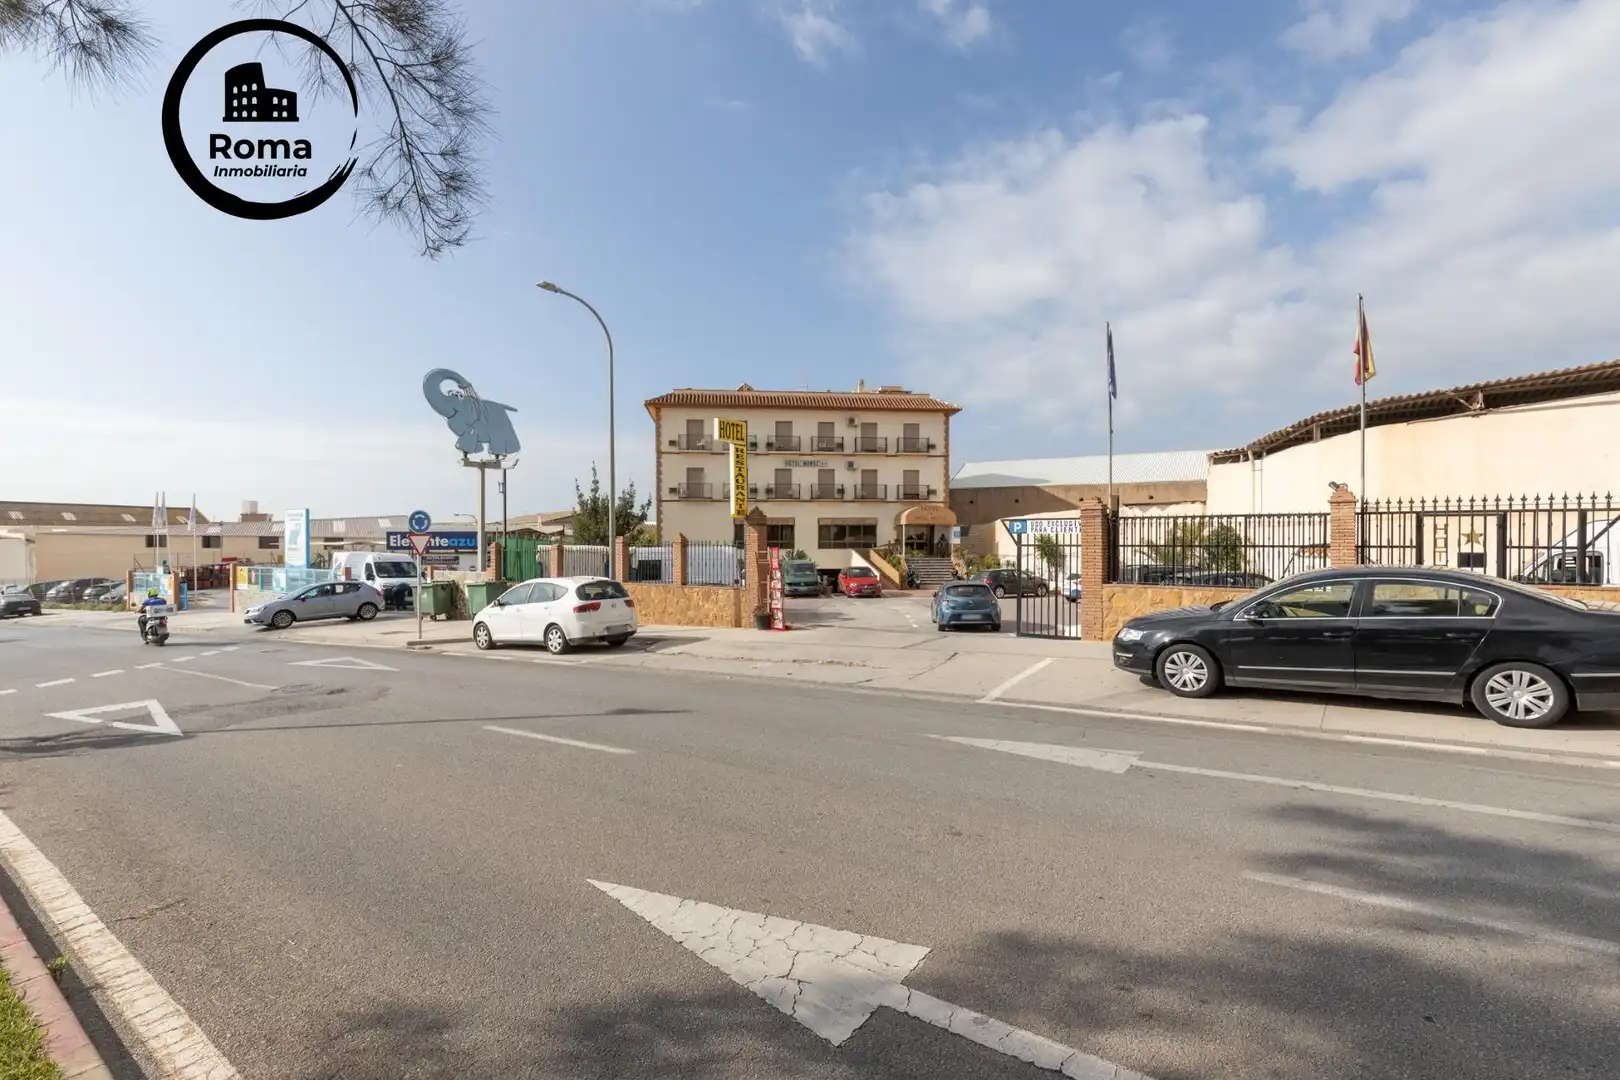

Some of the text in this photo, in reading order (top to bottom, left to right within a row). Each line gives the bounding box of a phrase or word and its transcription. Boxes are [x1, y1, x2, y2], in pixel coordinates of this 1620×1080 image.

[719, 420, 745, 442] HOTEL
[735, 447, 746, 516] RESTAURANTE
[1014, 522, 1022, 532] P
